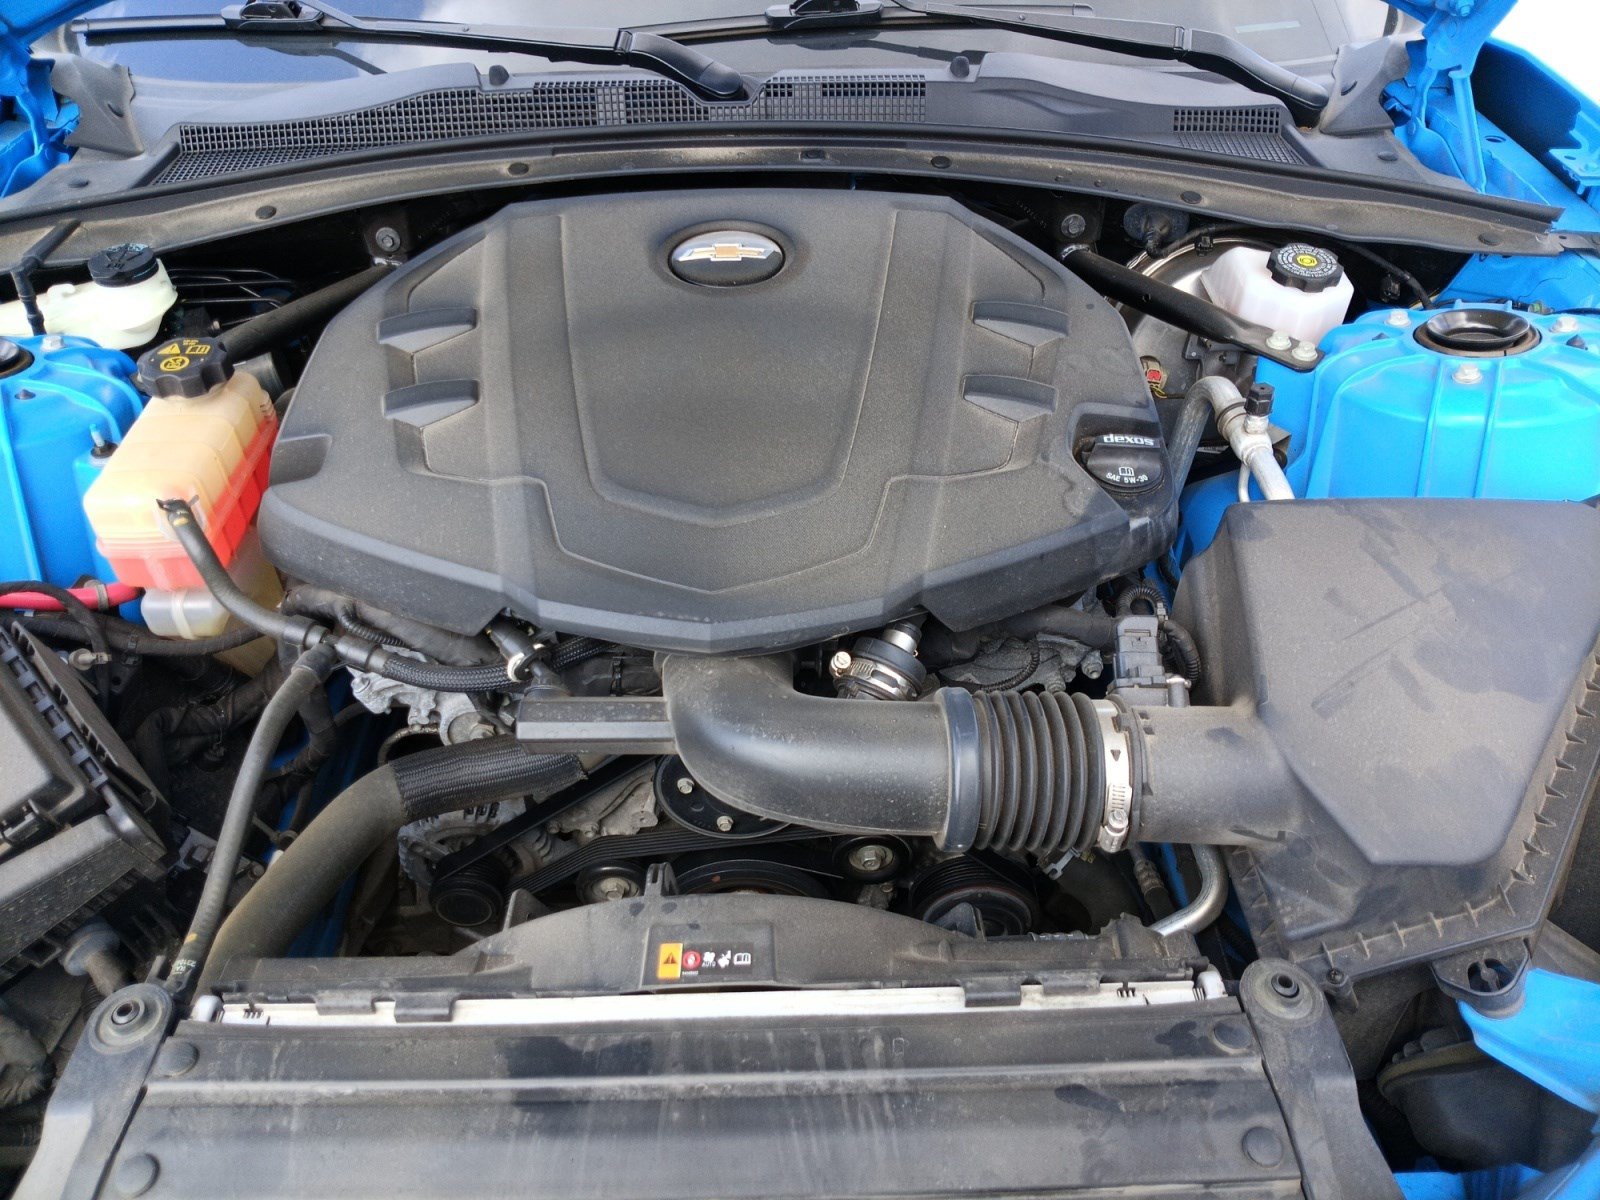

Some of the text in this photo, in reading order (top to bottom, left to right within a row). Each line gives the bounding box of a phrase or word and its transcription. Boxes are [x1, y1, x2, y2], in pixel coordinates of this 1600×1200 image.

[1103, 433, 1154, 446] dexos
[1106, 472, 1149, 484] SAE 5W-30
[702, 960, 716, 968] AUTO
